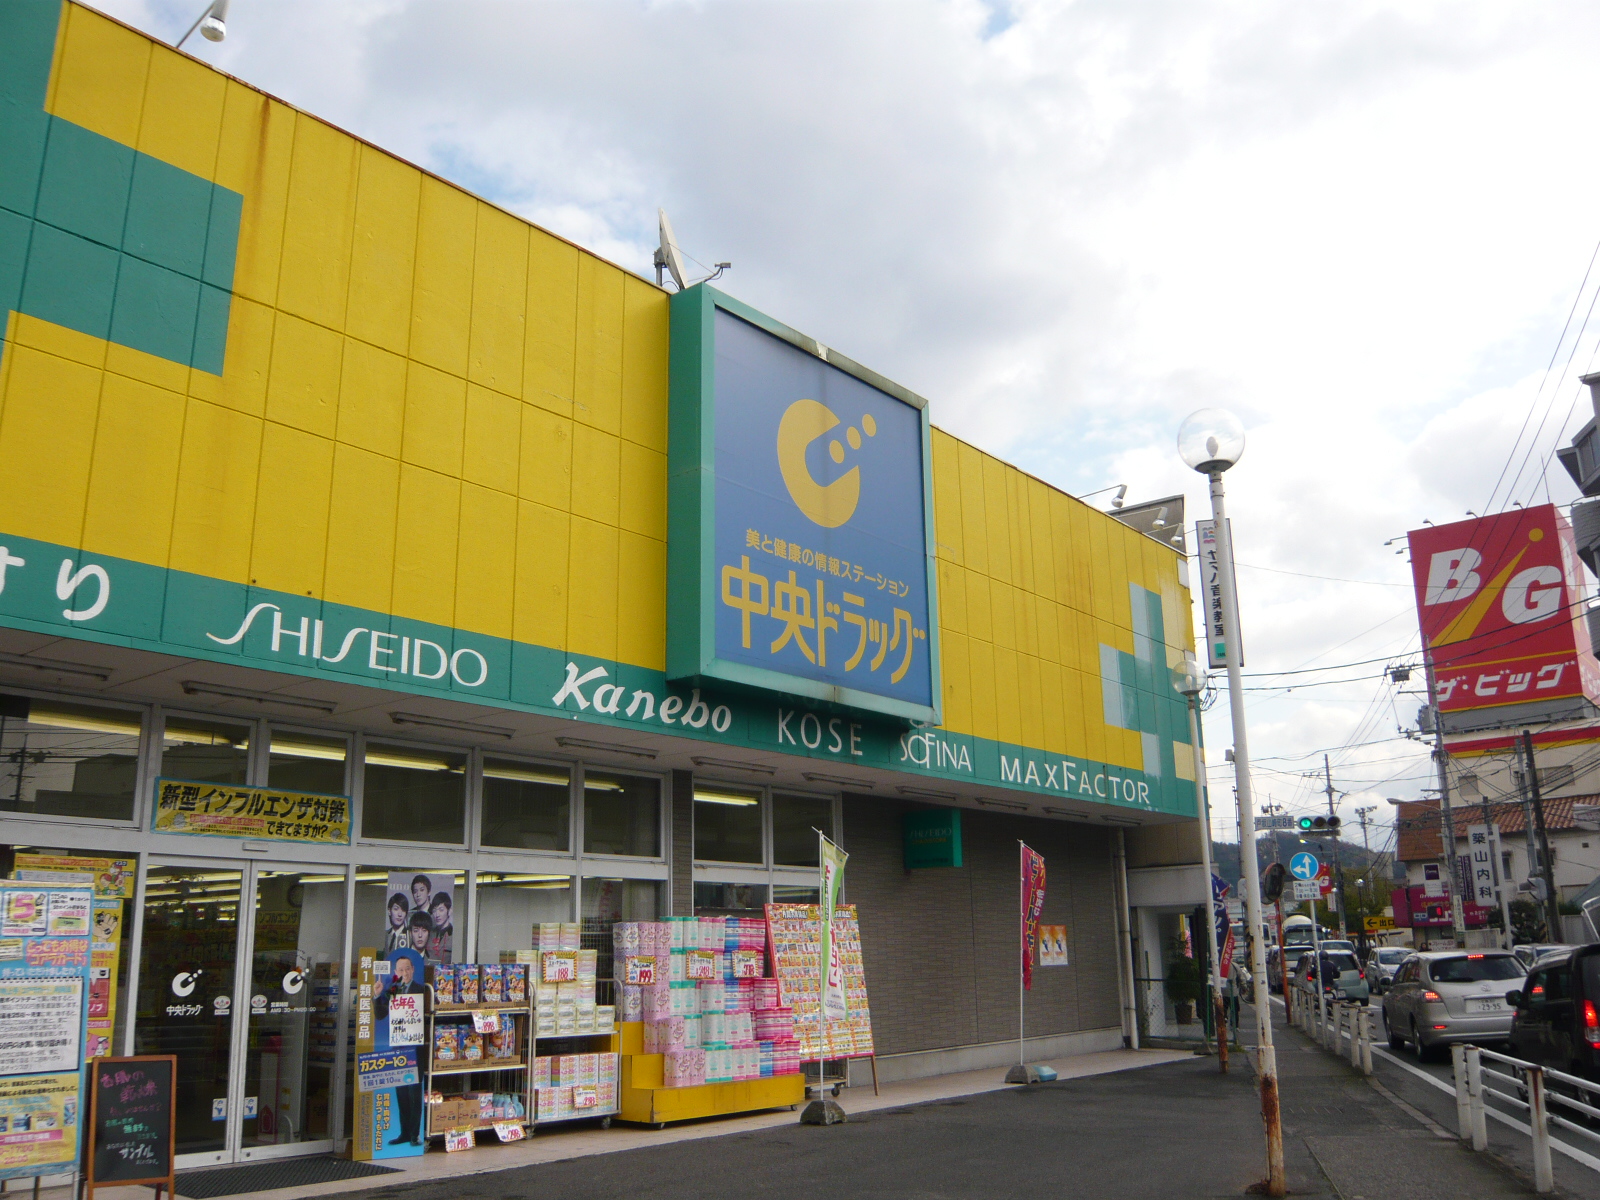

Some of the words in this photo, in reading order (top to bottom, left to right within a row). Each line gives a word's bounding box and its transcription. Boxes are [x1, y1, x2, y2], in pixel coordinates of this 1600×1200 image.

[746, 528, 909, 598] 美と健康の情報ステーション
[205, 602, 488, 687] SHISEIDO
[721, 555, 927, 685] 中央ドラッグ
[551, 661, 732, 733] Kanebo
[777, 707, 864, 756] KOSE
[900, 732, 972, 772] SOFINA
[158, 784, 346, 823] 新型インフルエンザ対策
[266, 820, 329, 838] できてますか?
[389, 882, 410, 891] uno
[1472, 832, 1493, 899] 築山内科
[358, 956, 373, 1039] 第1類医薬品
[360, 1055, 407, 1072] ガスター10
[118, 1143, 155, 1160] サンプル
